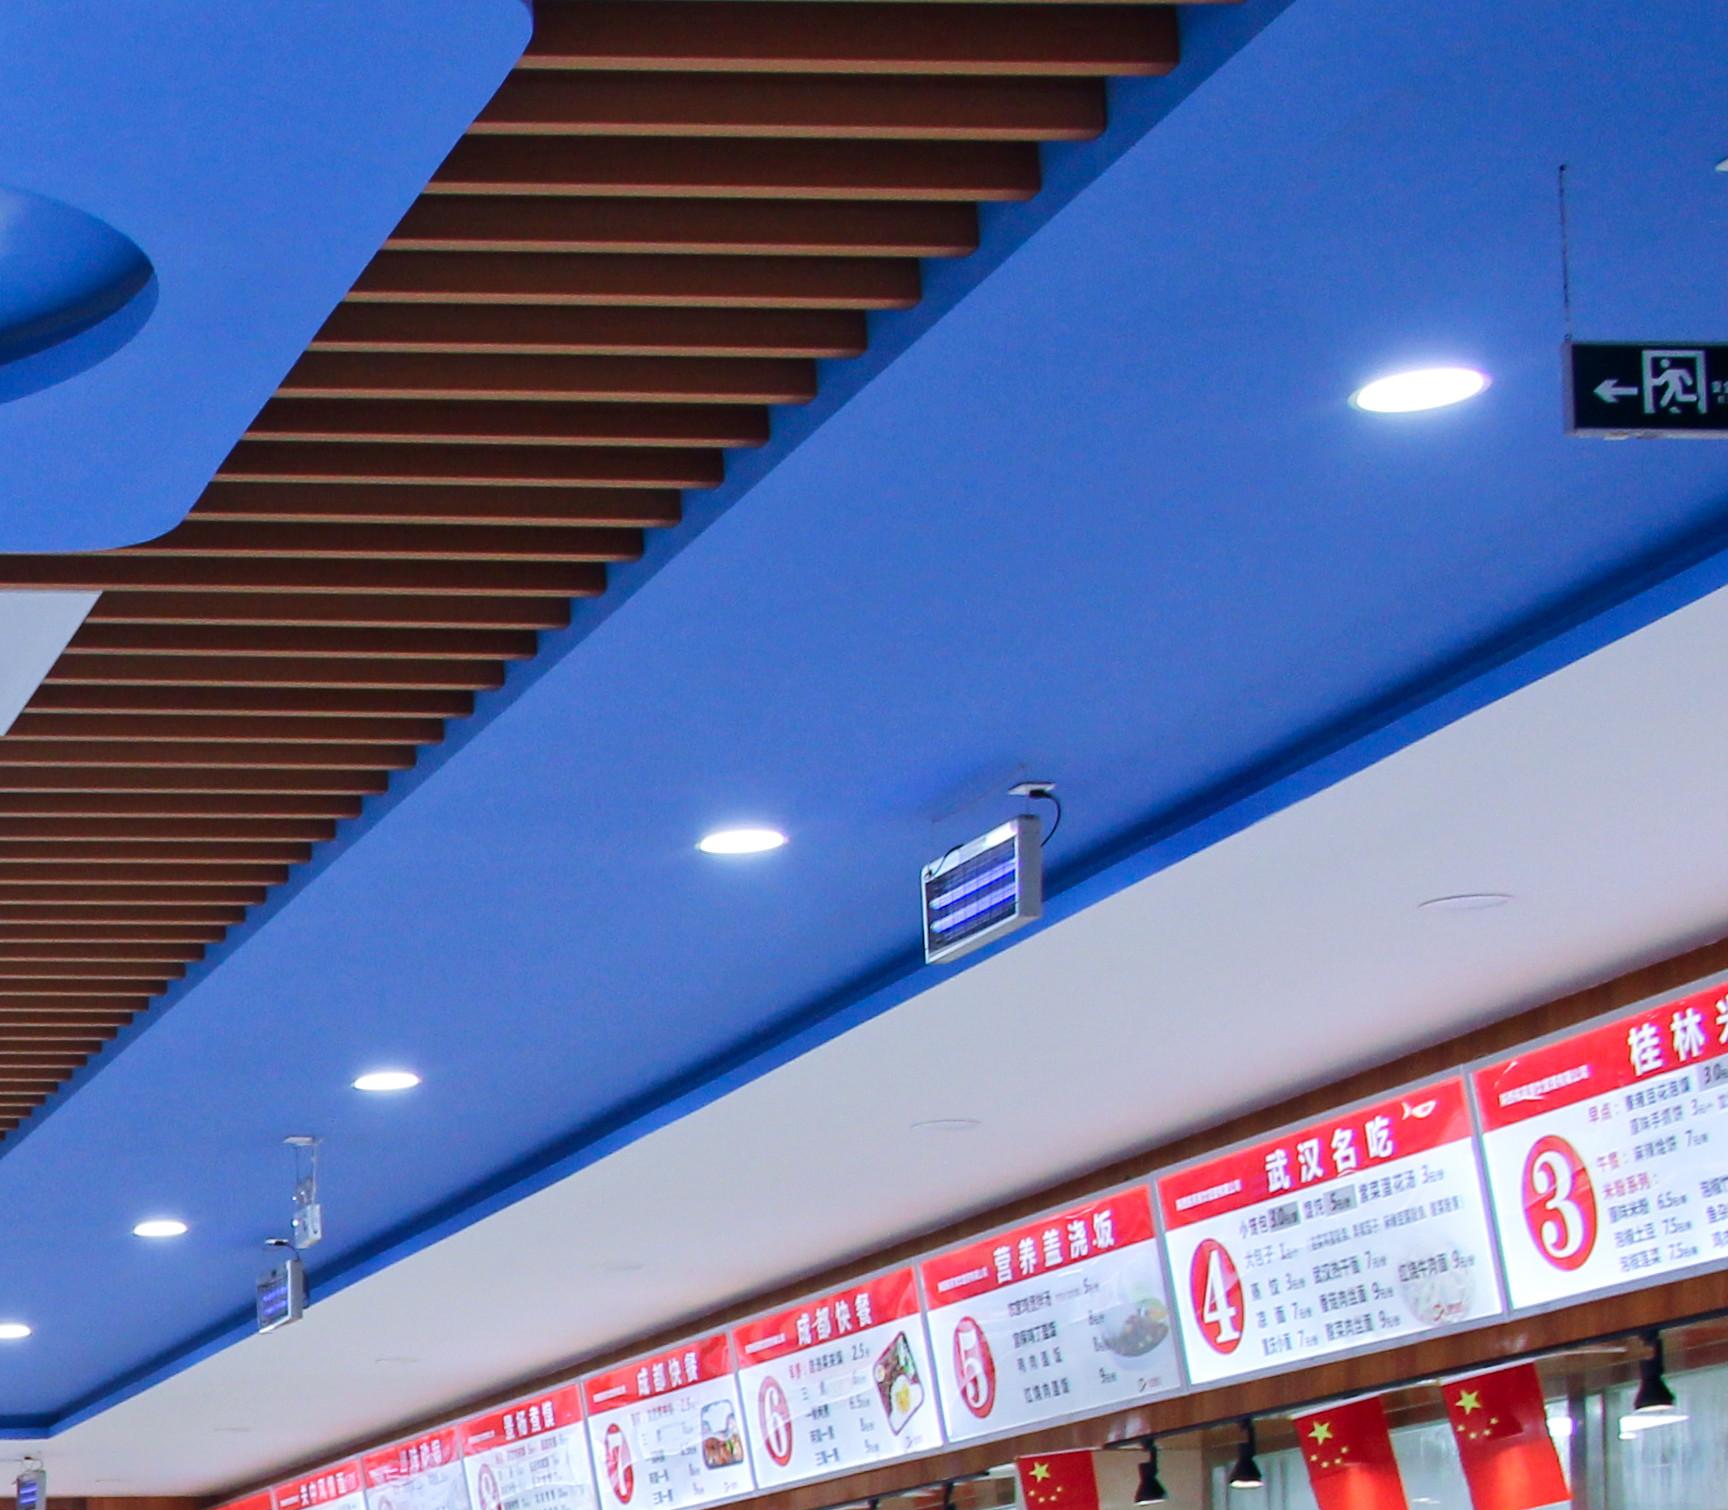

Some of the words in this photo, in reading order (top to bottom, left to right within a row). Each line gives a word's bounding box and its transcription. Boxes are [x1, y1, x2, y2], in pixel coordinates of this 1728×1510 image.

[1265, 1114, 1394, 1193] 武汉名吃
[1532, 1150, 1584, 1259] 3
[993, 1209, 1116, 1284] 营养盖浇饭
[795, 1292, 873, 1347] 成都快餐
[1203, 1250, 1240, 1344] 4
[957, 1331, 990, 1409] 5
[763, 1386, 790, 1459] 6
[607, 1430, 630, 1498] 7
